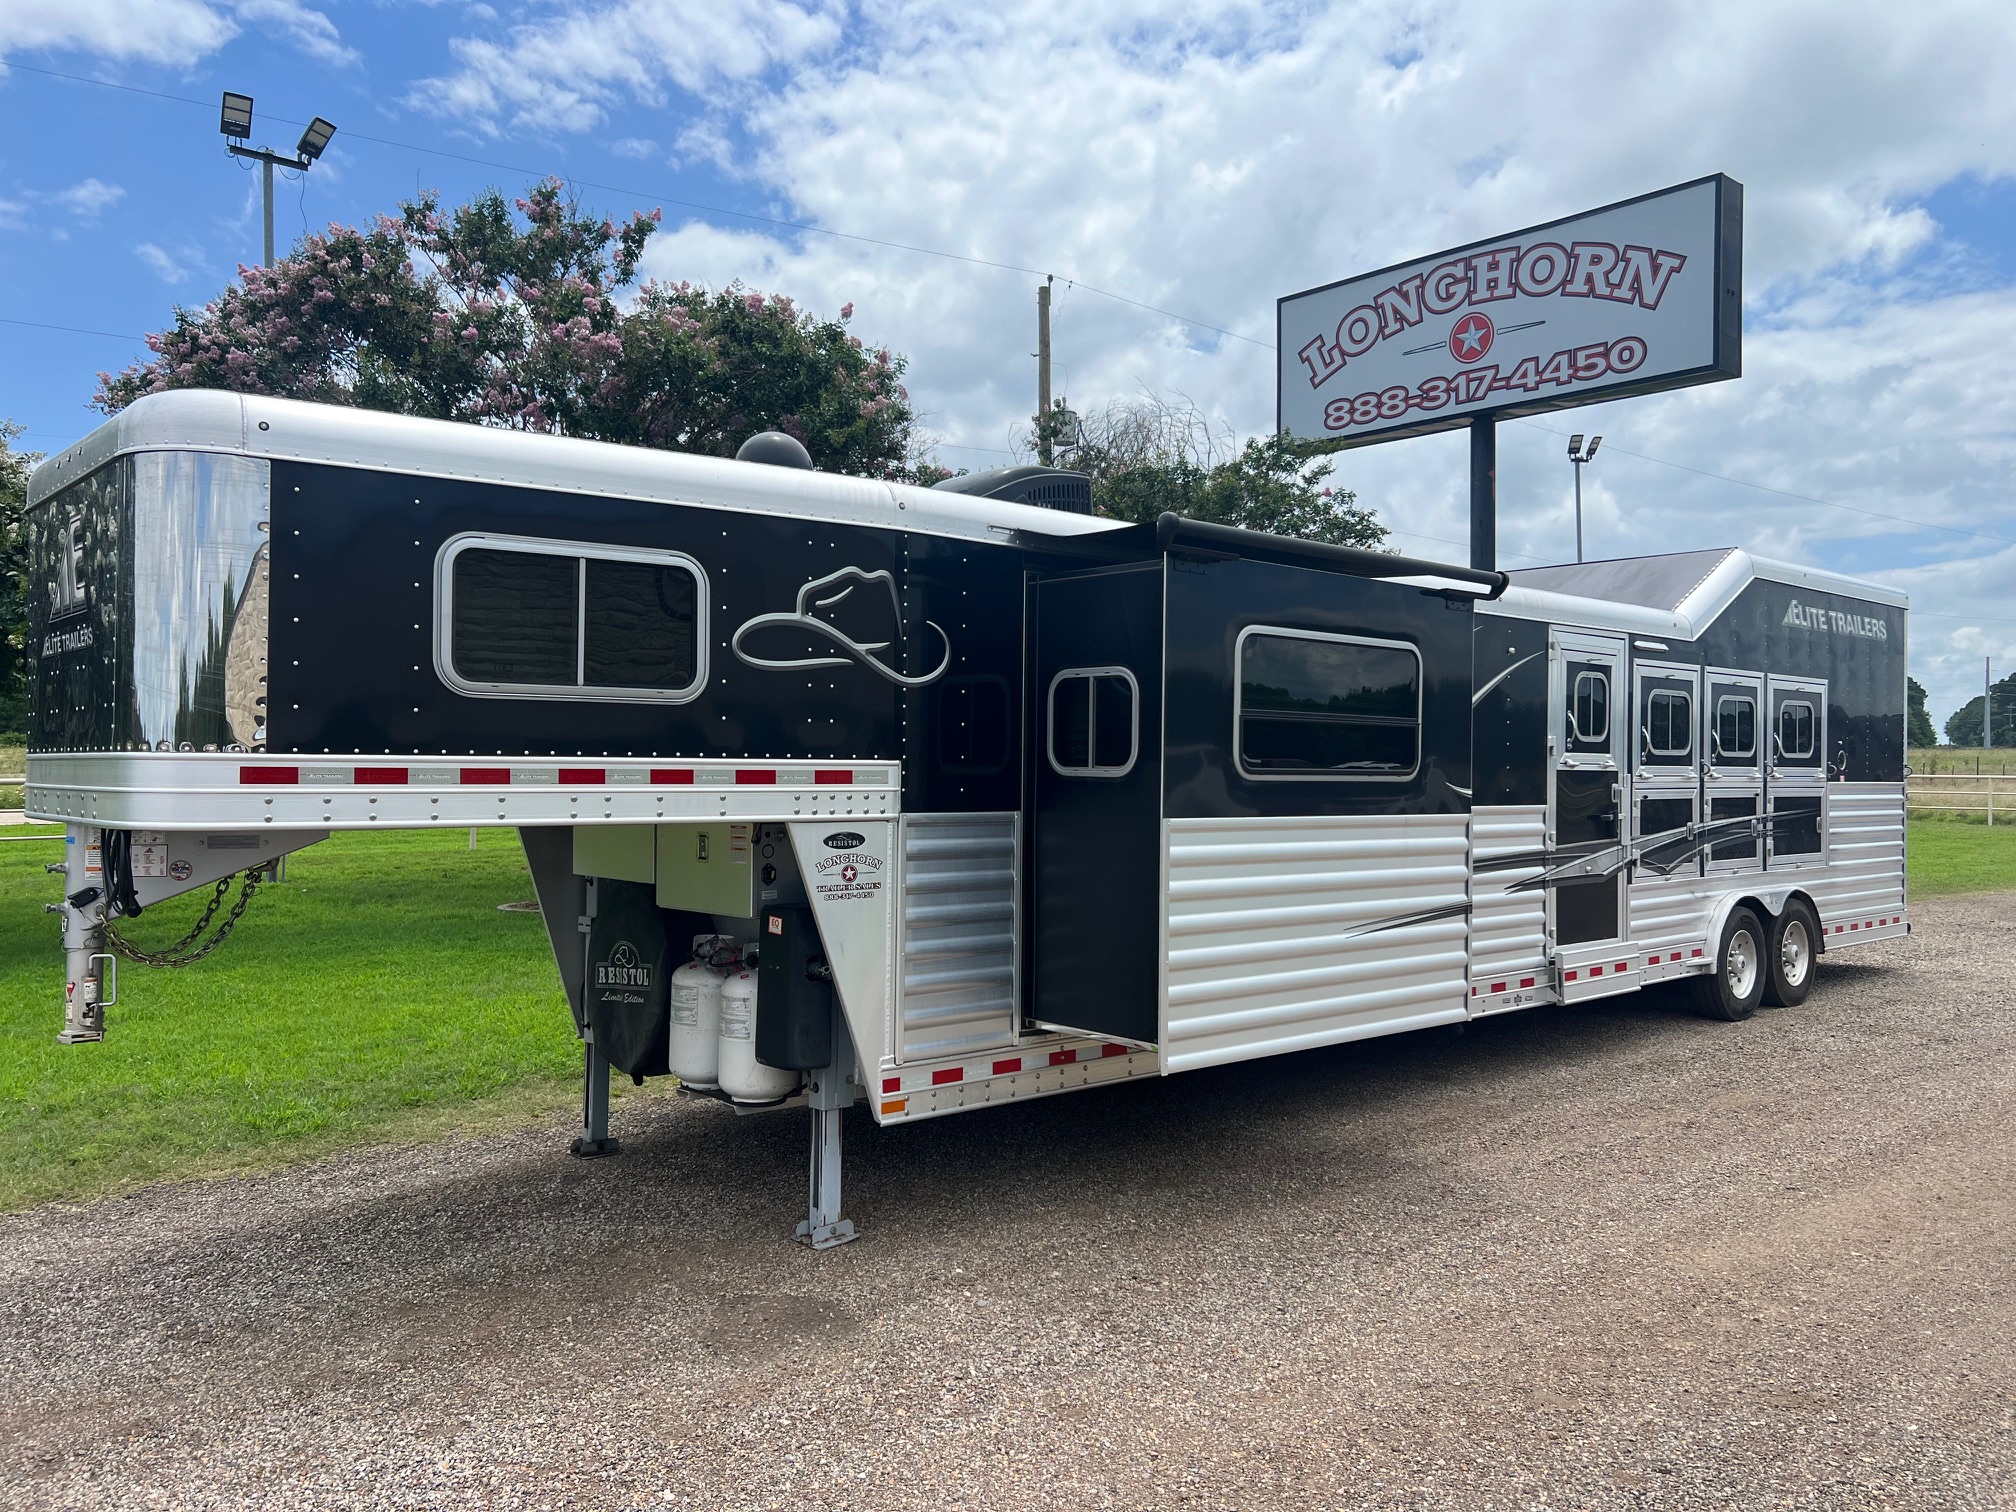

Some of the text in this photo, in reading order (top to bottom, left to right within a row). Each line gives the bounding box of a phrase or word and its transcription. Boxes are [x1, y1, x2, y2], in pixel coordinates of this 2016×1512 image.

[1298, 241, 1688, 389] LONGHORN
[1323, 336, 1648, 430] 888-317-4450
[1781, 600, 1887, 641] ELITE TRAILERS
[41, 627, 94, 659] ELITE TRAILERS
[815, 853, 883, 873] LONGHORN
[817, 882, 882, 892] TRAILER SALES
[772, 919, 780, 929] EQ
[599, 967, 649, 985] RESISTOL
[623, 993, 645, 1003] Edition
